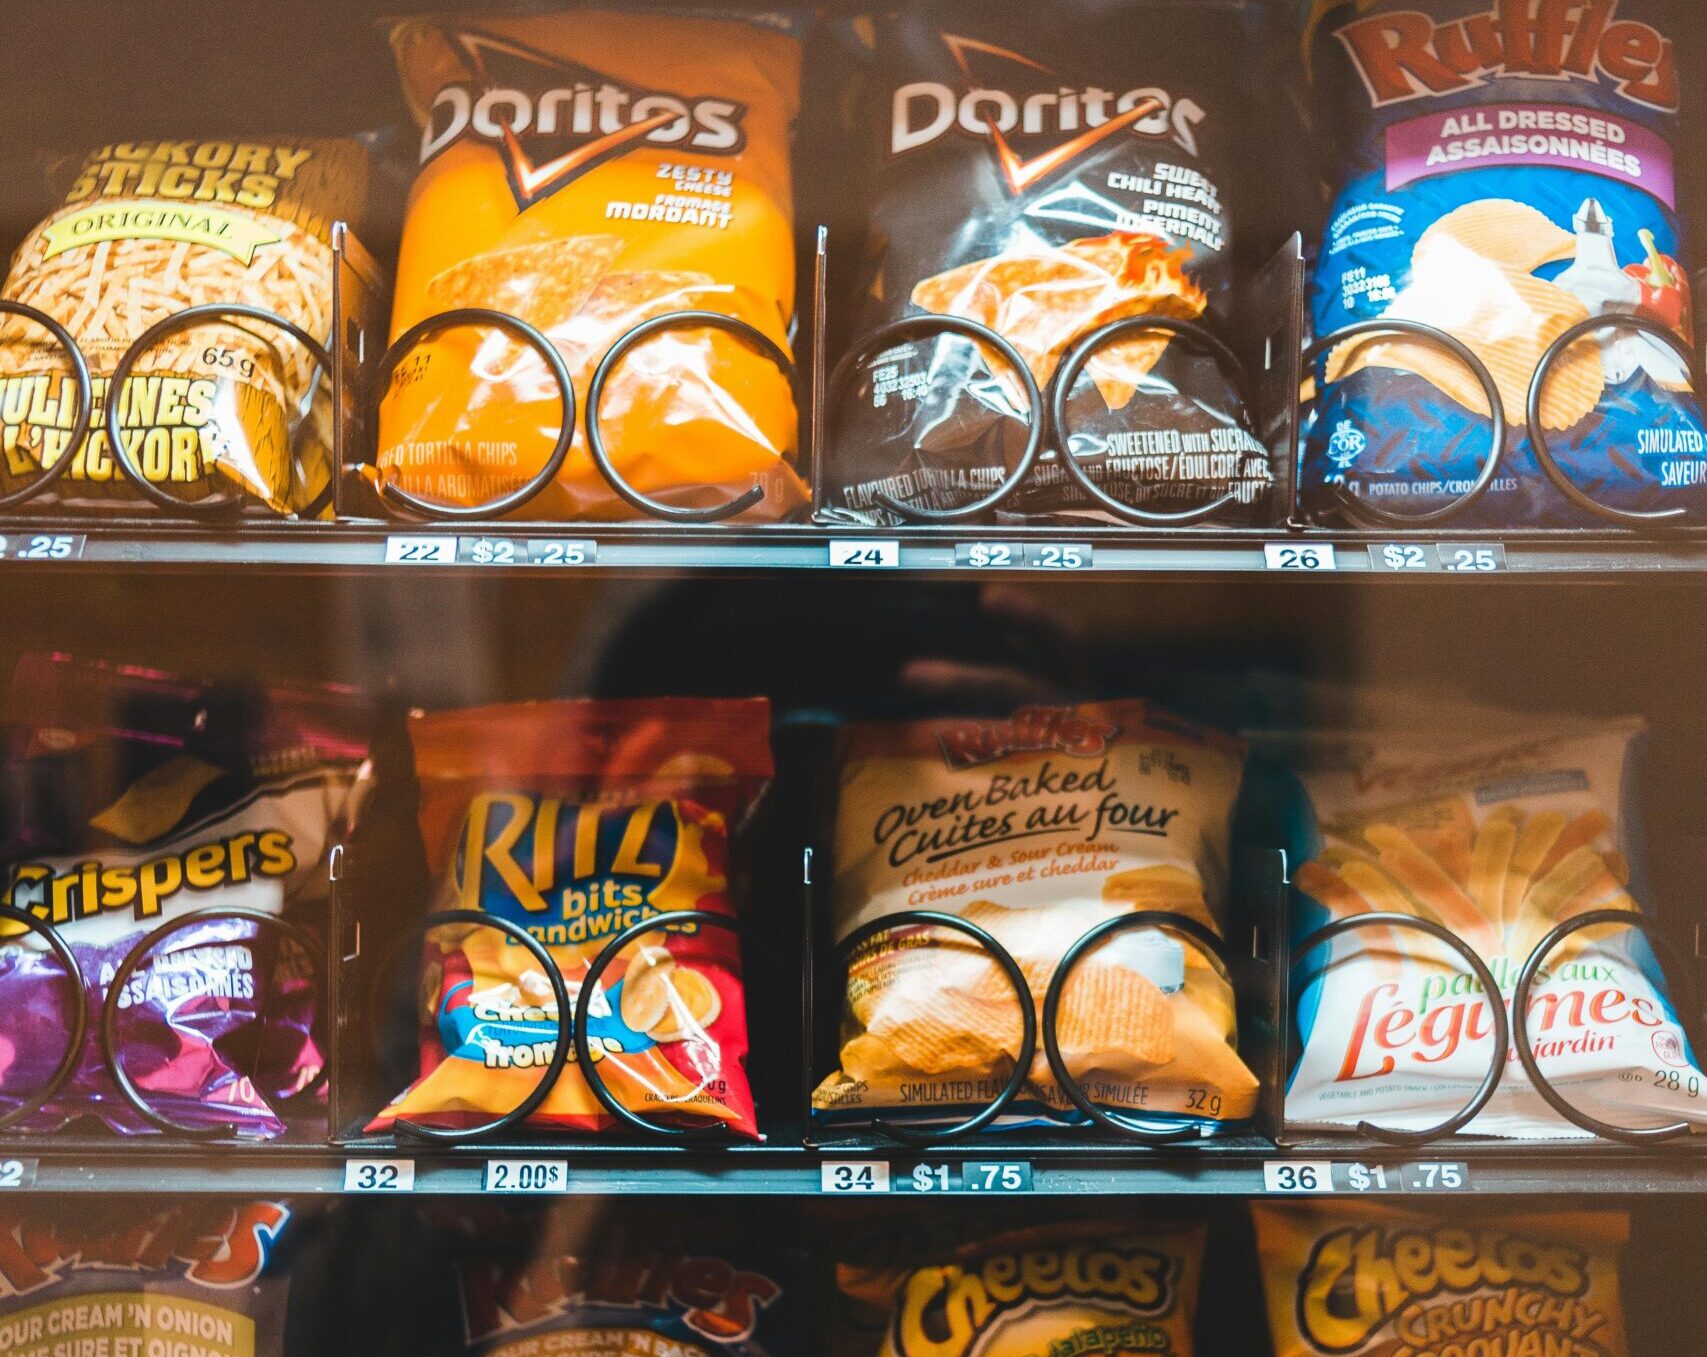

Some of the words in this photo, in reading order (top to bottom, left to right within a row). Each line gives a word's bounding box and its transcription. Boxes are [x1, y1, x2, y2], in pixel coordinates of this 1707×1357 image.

[1334, 0, 1680, 113] Ruffles
[420, 82, 738, 165] Doritos
[891, 81, 1206, 157] Doritos
[1440, 112, 1493, 138] ALL
[1499, 110, 1627, 144] DRESSED
[95, 140, 312, 180] CKORY
[1425, 136, 1642, 178] ASSAISONNÉES
[66, 161, 280, 209] STICKS
[656, 162, 734, 186] ZESTY
[1108, 172, 1163, 196] CHILI
[71, 210, 234, 240] ORIGINAL
[605, 201, 733, 230] MORDANT
[1143, 199, 1222, 234] PIMENT
[202, 347, 235, 367] 65
[477, 441, 517, 465] CHIPS
[1106, 429, 1181, 457] SWEETENED
[1181, 433, 1210, 453] WITH
[1637, 428, 1703, 454] SIMULATED
[969, 466, 1006, 490] CHIPS
[1661, 460, 1707, 486] SAVEUR
[1369, 484, 1409, 497] POTATO
[17, 536, 74, 559] .25
[400, 543, 440, 561] 22
[471, 539, 515, 564] $2
[533, 543, 585, 564] .25
[843, 549, 884, 566] 24
[968, 542, 1011, 567] $2
[1032, 547, 1083, 568] .25
[1279, 549, 1320, 568] 26
[1383, 545, 1427, 570] $2
[1446, 549, 1497, 571] .25
[873, 789, 984, 845] Oven
[983, 758, 1116, 804] Baked
[888, 811, 1014, 868] Cuites
[1024, 801, 1088, 831] au
[1085, 792, 1179, 843] four
[461, 791, 663, 913] RITZ
[1009, 847, 1053, 866] Sour
[1055, 840, 1121, 857] Cream
[3, 830, 297, 922] Crispers
[907, 880, 969, 907] Crème
[970, 872, 1014, 893] sure
[1016, 866, 1036, 885] et
[1038, 855, 1120, 882] cheddar
[561, 880, 643, 922] bits
[1560, 961, 1621, 986] aux
[102, 972, 255, 1010] SSAISONNÉS
[1334, 984, 1663, 1083] Légumes
[1532, 1029, 1615, 1060] jardin
[899, 1081, 973, 1103] SIMULATED
[1093, 1082, 1150, 1106] SIMULÉE
[1318, 1089, 1358, 1101] VEGETABLE
[1375, 1084, 1402, 1096] POTATO
[1654, 1069, 1680, 1090] 28
[1688, 1076, 1699, 1098] g
[1184, 1087, 1206, 1111] 32
[1209, 1094, 1222, 1117] g
[358, 1165, 399, 1189] 32
[493, 1164, 559, 1190] 2.00$
[834, 1166, 875, 1190] 34
[912, 1163, 950, 1193] $1
[971, 1165, 1022, 1191] .75
[1277, 1165, 1318, 1190] 36
[1348, 1162, 1387, 1192] $1
[1412, 1164, 1462, 1188] .75
[1303, 1229, 1587, 1350] Cheetos
[0, 1316, 43, 1350] OUR
[47, 1304, 123, 1336] CREAM
[157, 1306, 234, 1347] ONION
[1398, 1290, 1607, 1347] CRUNCHY
